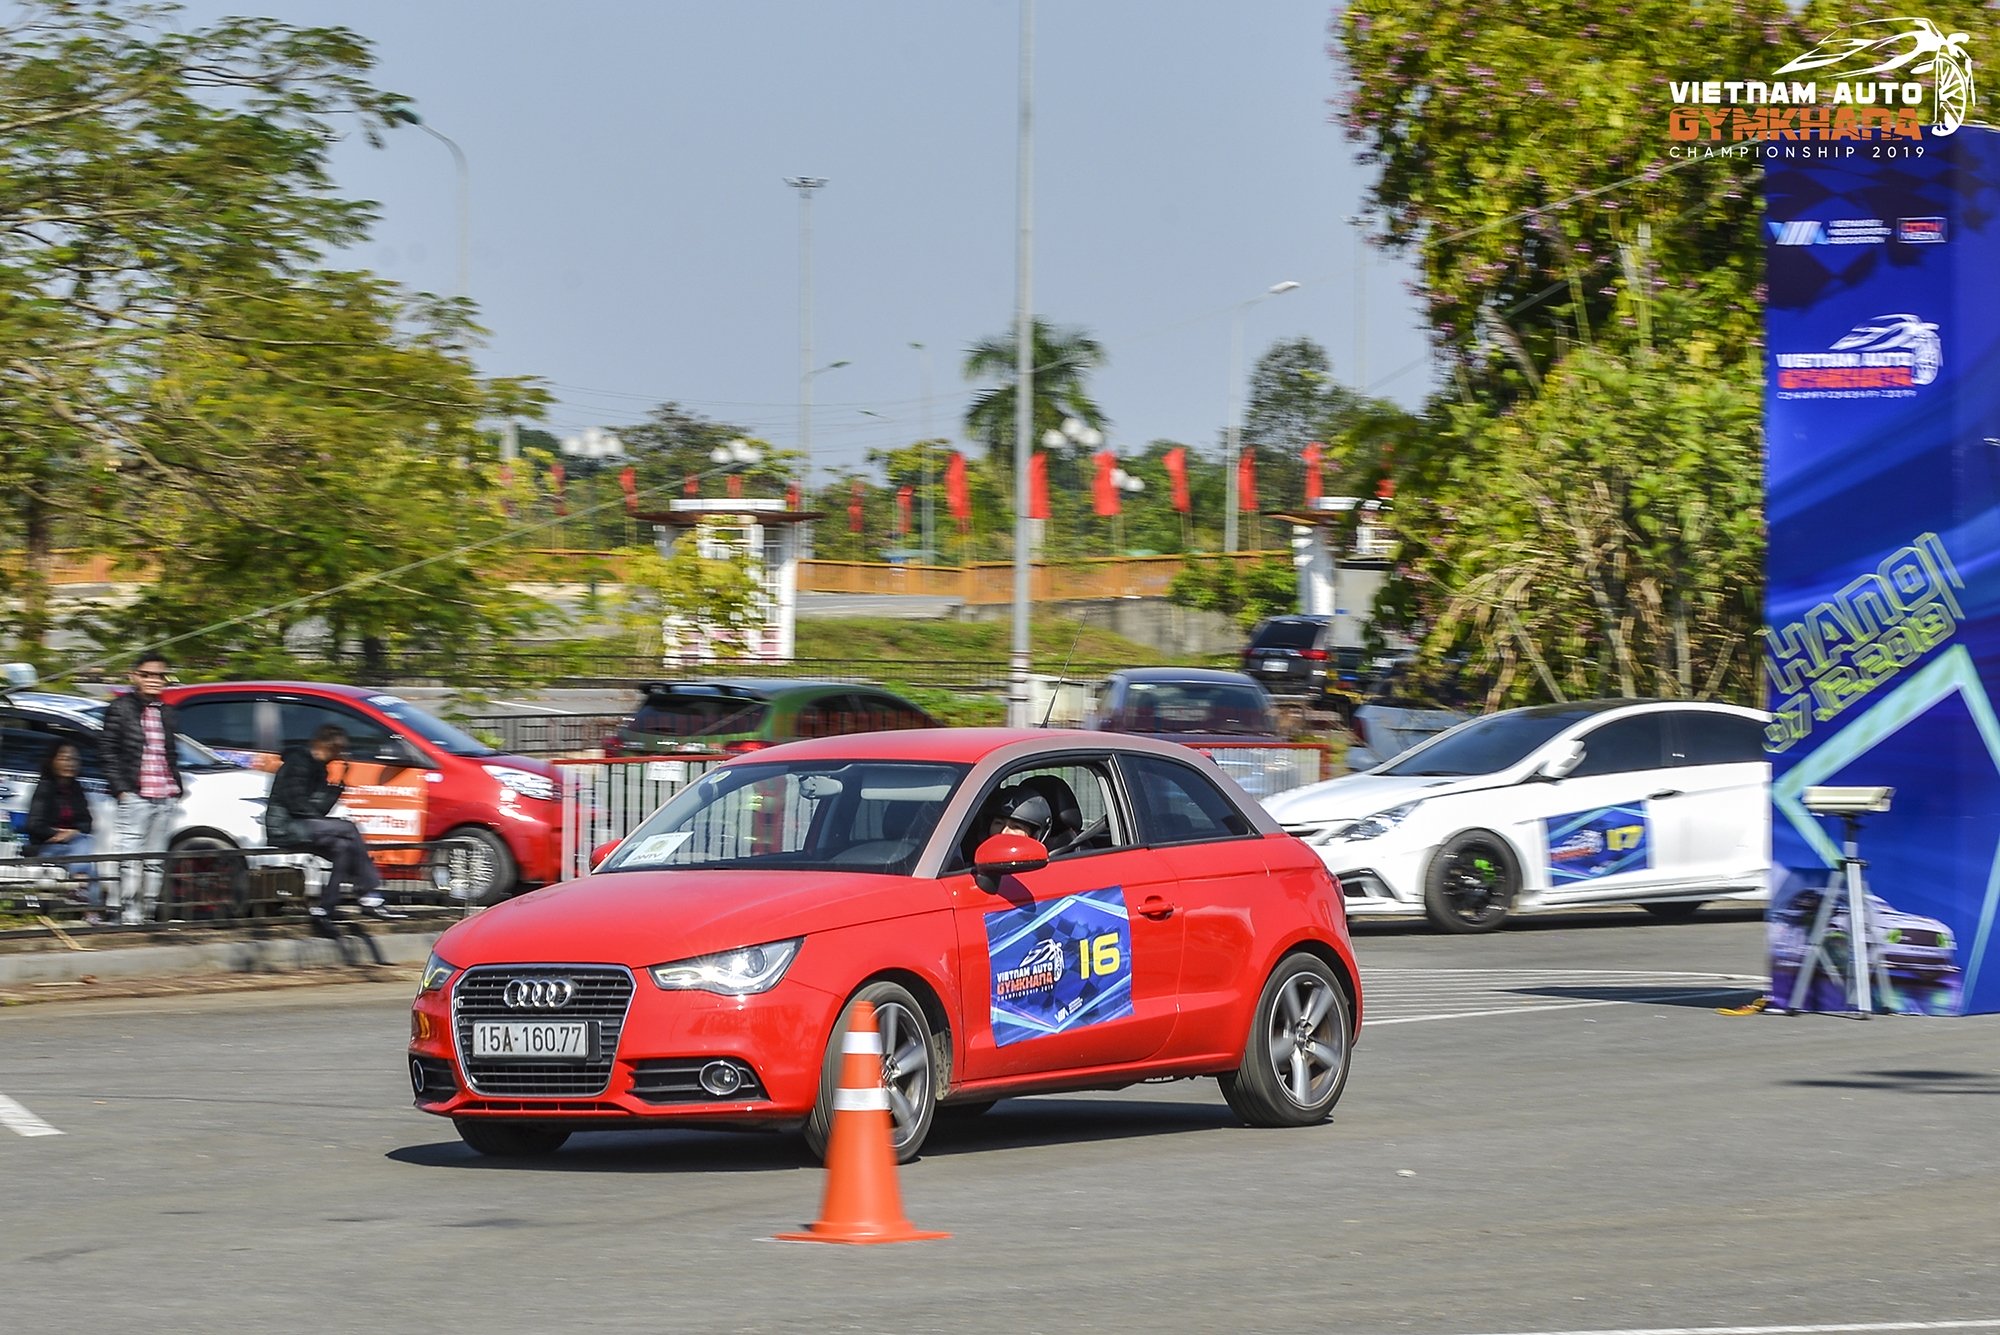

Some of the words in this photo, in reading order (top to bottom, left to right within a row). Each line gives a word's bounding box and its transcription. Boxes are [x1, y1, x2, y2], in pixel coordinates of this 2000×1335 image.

[1756, 532, 1965, 694] HANOI
[1079, 932, 1120, 980] 16
[996, 972, 1053, 995] GYMKHANA
[997, 966, 1030, 982] VIETNAM
[1033, 962, 1053, 975] AUTO
[480, 1026, 582, 1053] 15A-160.77
